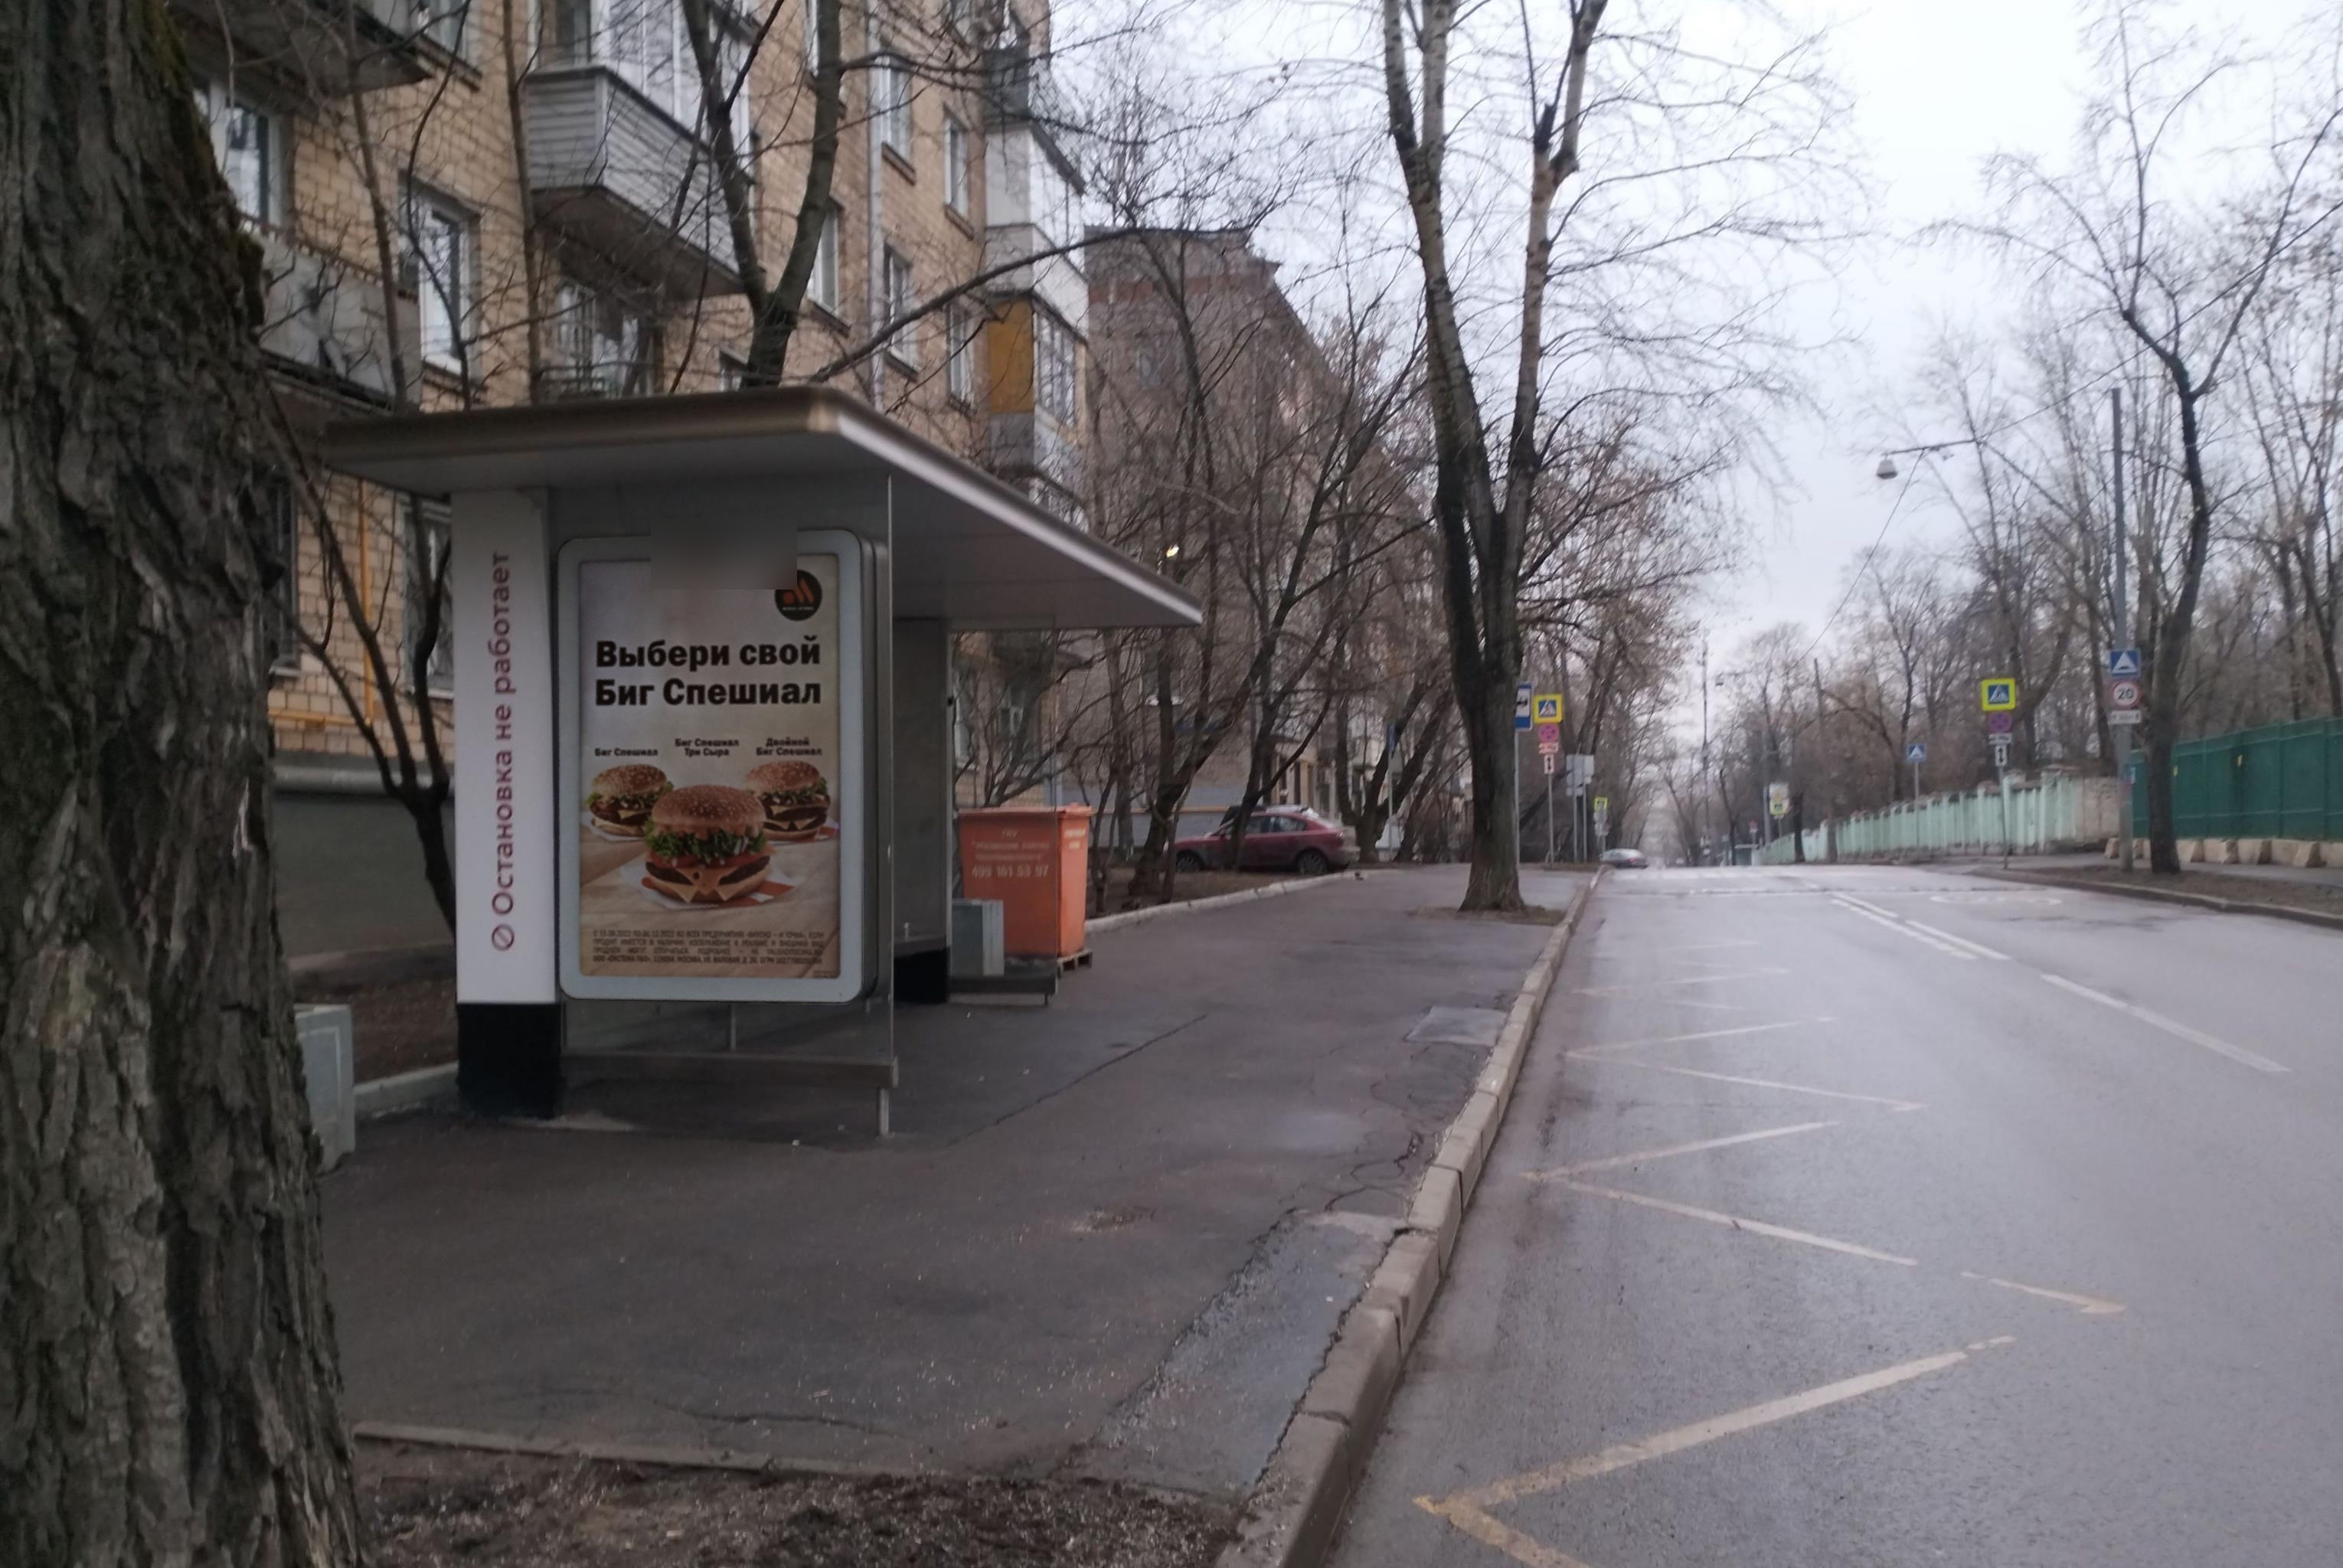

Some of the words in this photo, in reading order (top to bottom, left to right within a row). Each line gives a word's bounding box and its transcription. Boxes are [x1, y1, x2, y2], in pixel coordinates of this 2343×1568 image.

[488, 550, 517, 695] работает
[596, 639, 730, 671] Выбери
[740, 635, 820, 665] свой
[596, 679, 655, 706] Биг
[663, 678, 821, 705] Спешиал
[2118, 688, 2135, 700] 20
[495, 704, 515, 741] не
[675, 739, 692, 747] Биг
[694, 738, 739, 746] Спешиал
[766, 737, 810, 746] Двойной
[594, 748, 612, 756] Биг
[614, 748, 658, 756] Спешиал
[685, 747, 701, 757] Три
[703, 747, 730, 758] Сыра
[756, 746, 773, 756] Биг
[776, 747, 822, 756] Спешиал
[490, 750, 515, 916] Остановка
